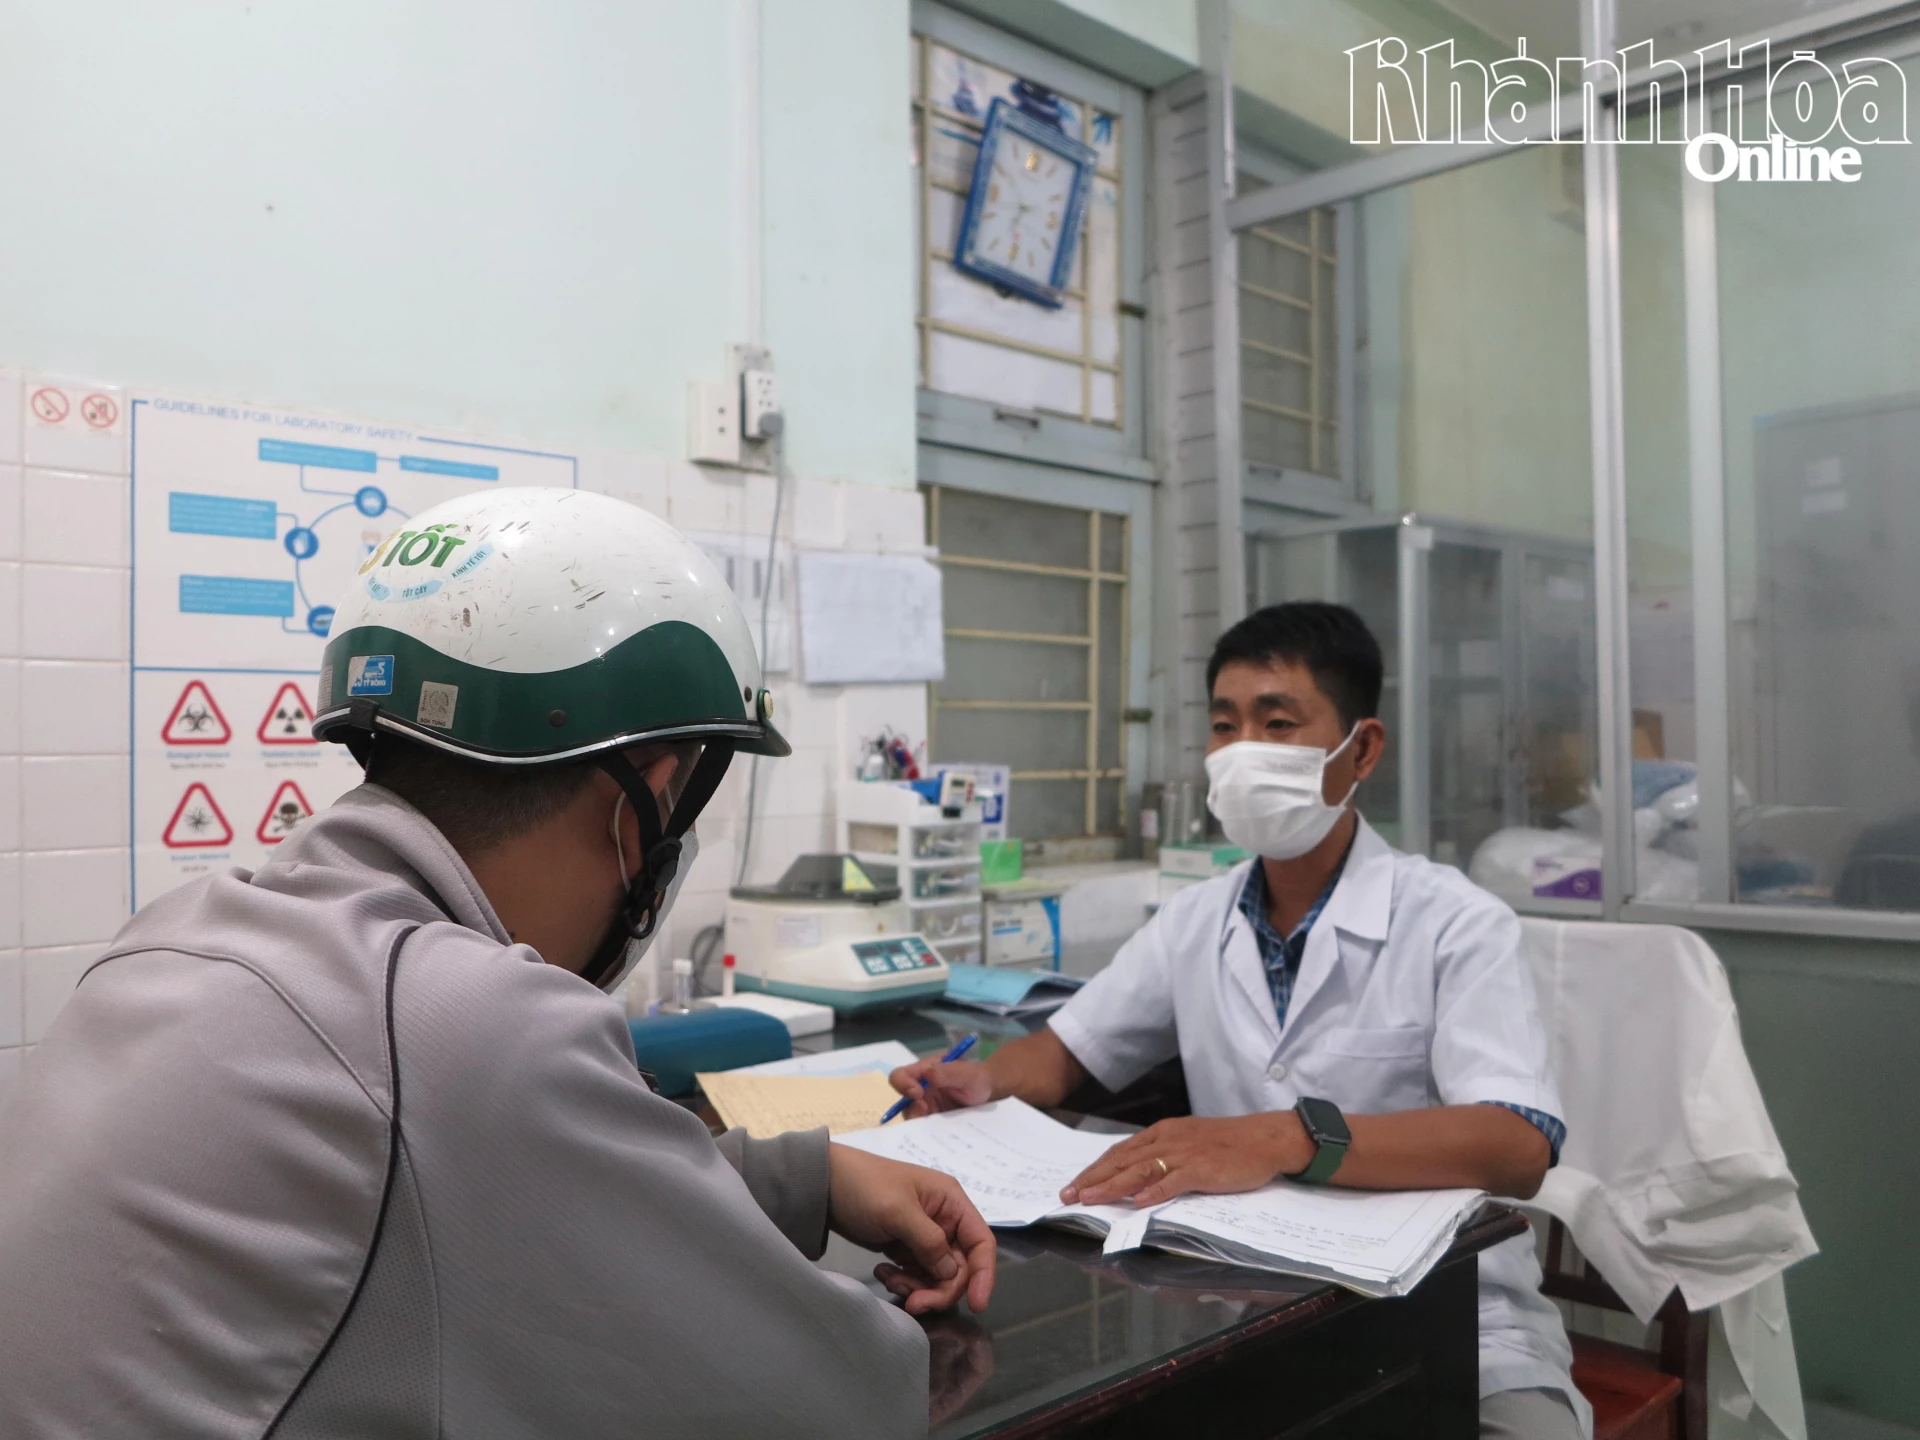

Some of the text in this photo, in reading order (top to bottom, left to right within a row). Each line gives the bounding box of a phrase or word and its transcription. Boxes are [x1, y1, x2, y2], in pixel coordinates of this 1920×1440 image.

[154, 398, 412, 441] GUIDELINES FOR LABORATORY SAFETY
[381, 523, 466, 568] TỐT
